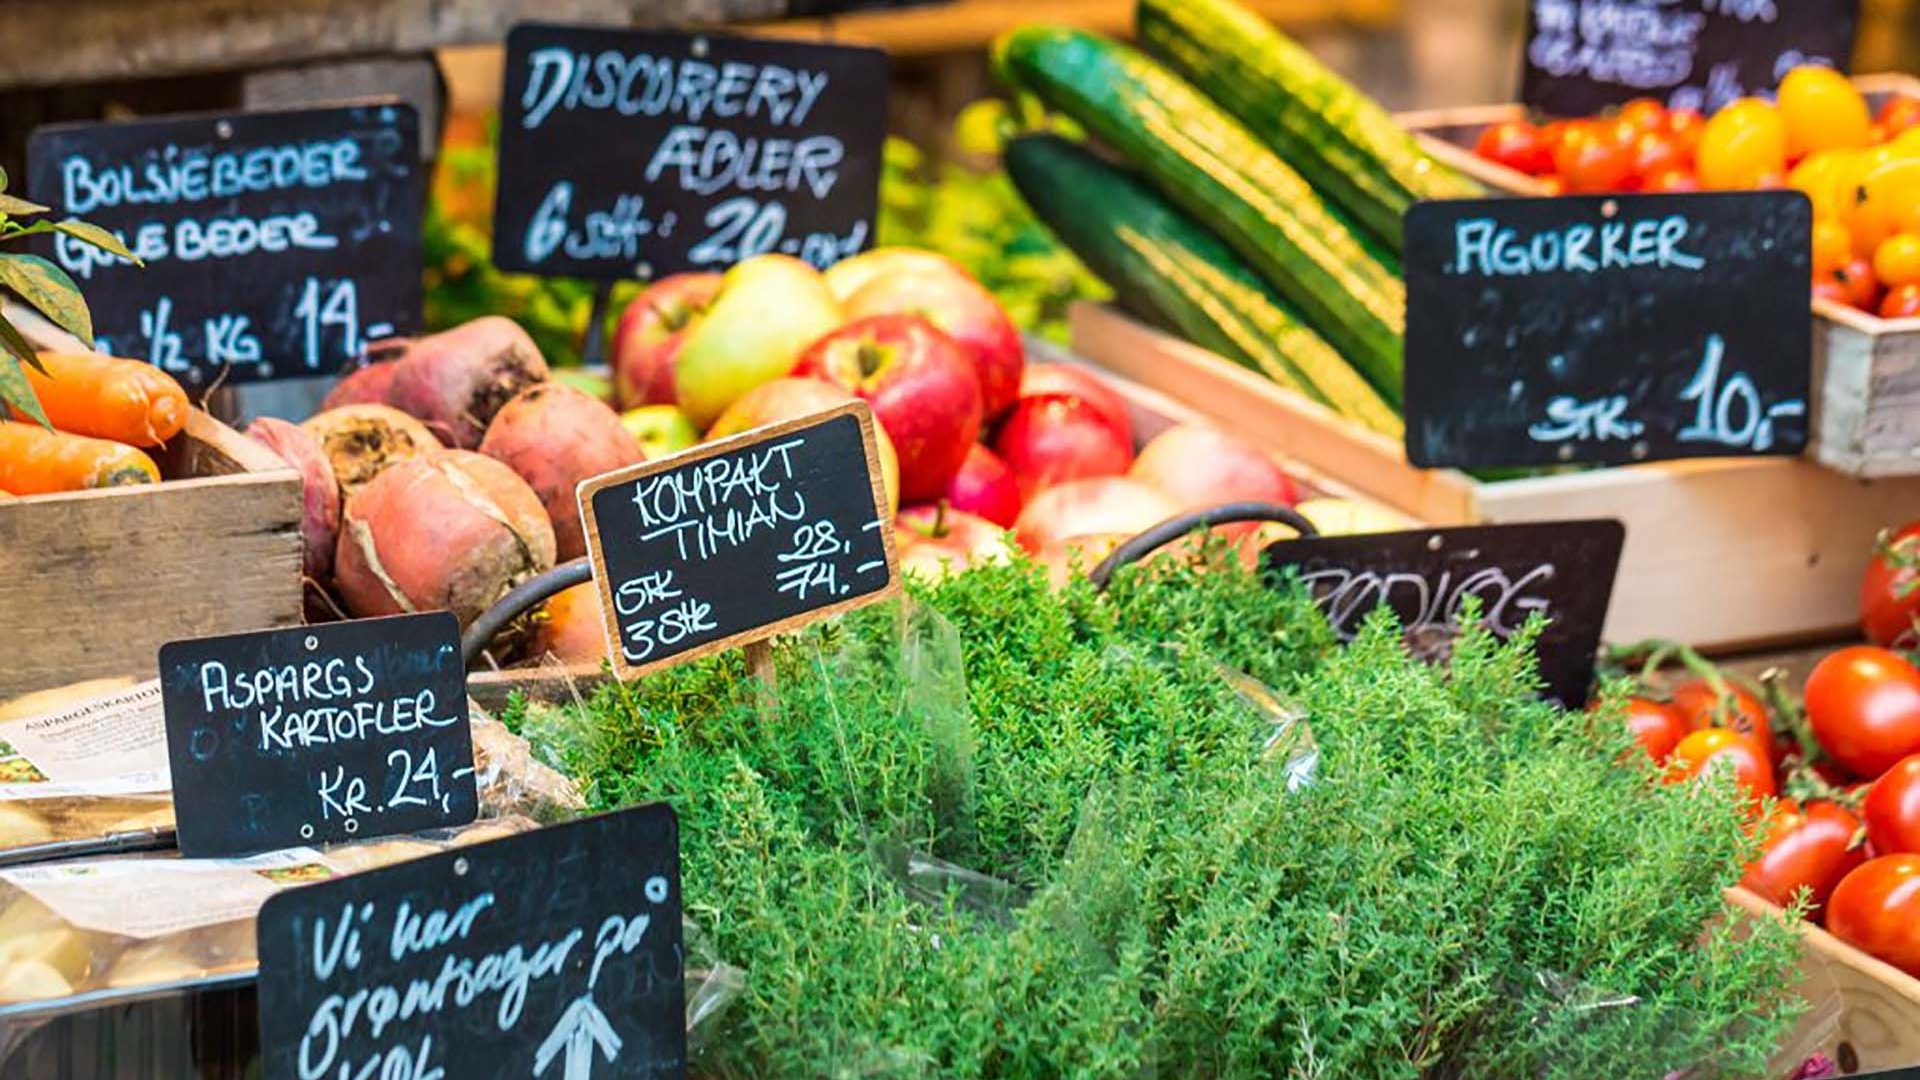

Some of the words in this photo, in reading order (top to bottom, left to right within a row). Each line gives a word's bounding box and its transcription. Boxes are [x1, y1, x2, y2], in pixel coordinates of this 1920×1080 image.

[174, 212, 338, 261] BEDER
[1455, 214, 1705, 276] AGURKER
[205, 313, 262, 365] KG
[632, 438, 804, 527] KOMPAKT
[640, 491, 805, 561] TIMIAN
[622, 619, 655, 661] 3
[201, 655, 375, 713] ASPARGS
[258, 688, 458, 751] KARTOFLER
[312, 900, 376, 981] Vi
[389, 891, 495, 962] har
